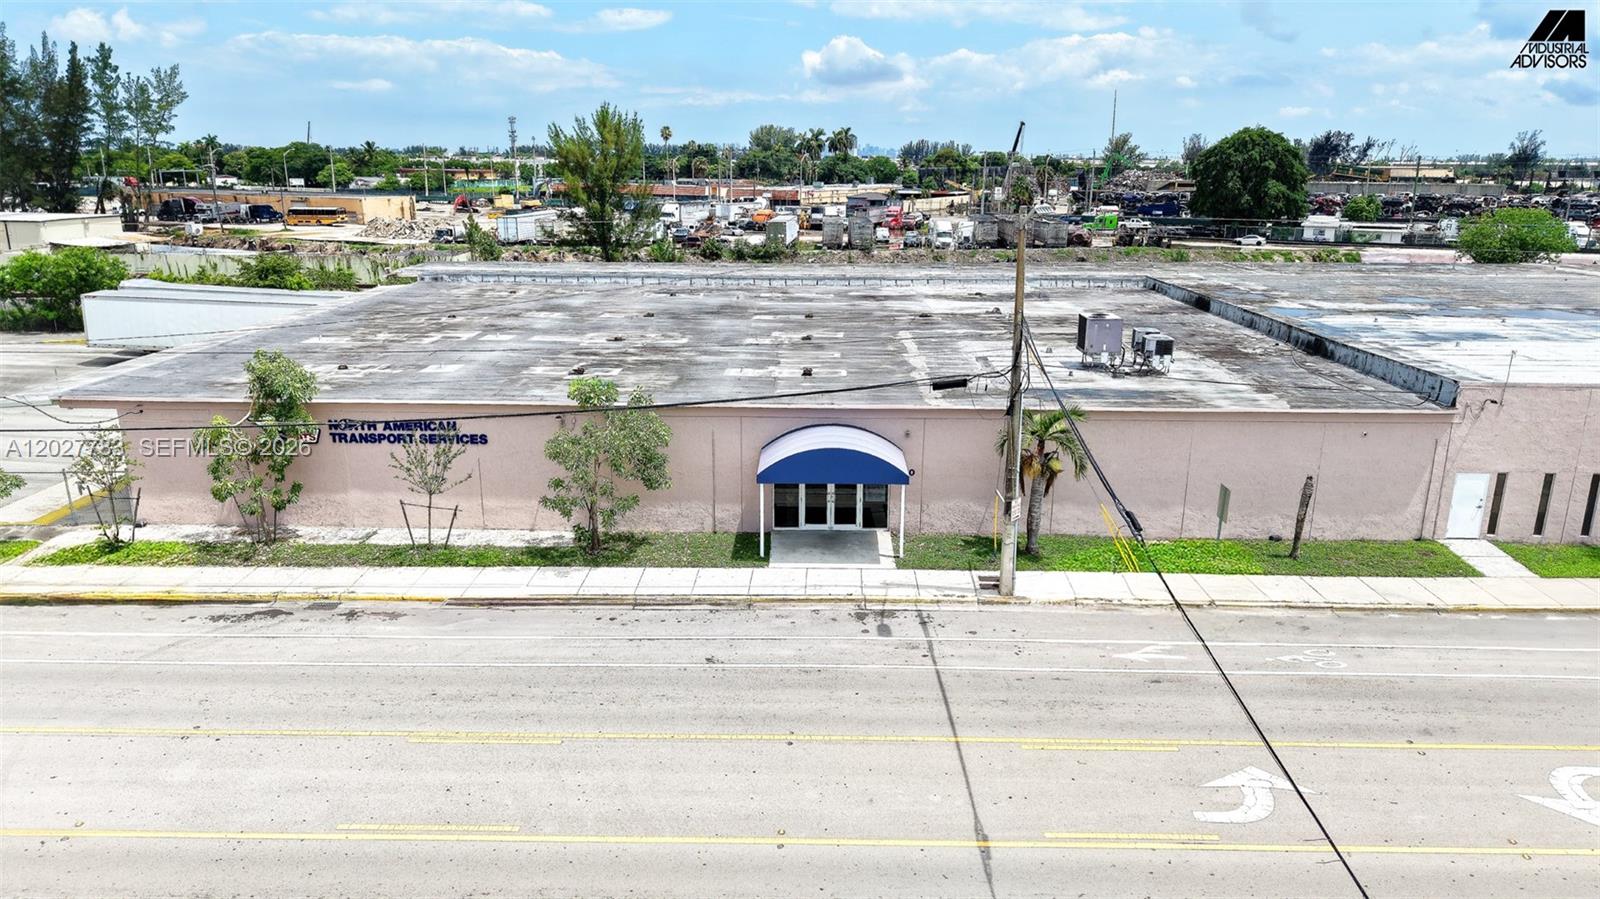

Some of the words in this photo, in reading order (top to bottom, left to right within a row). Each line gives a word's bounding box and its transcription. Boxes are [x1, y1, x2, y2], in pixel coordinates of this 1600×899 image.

[383, 420, 457, 431] AMERICAN
[329, 433, 415, 444] TRANSPORT
[419, 434, 488, 445] SERVICES
